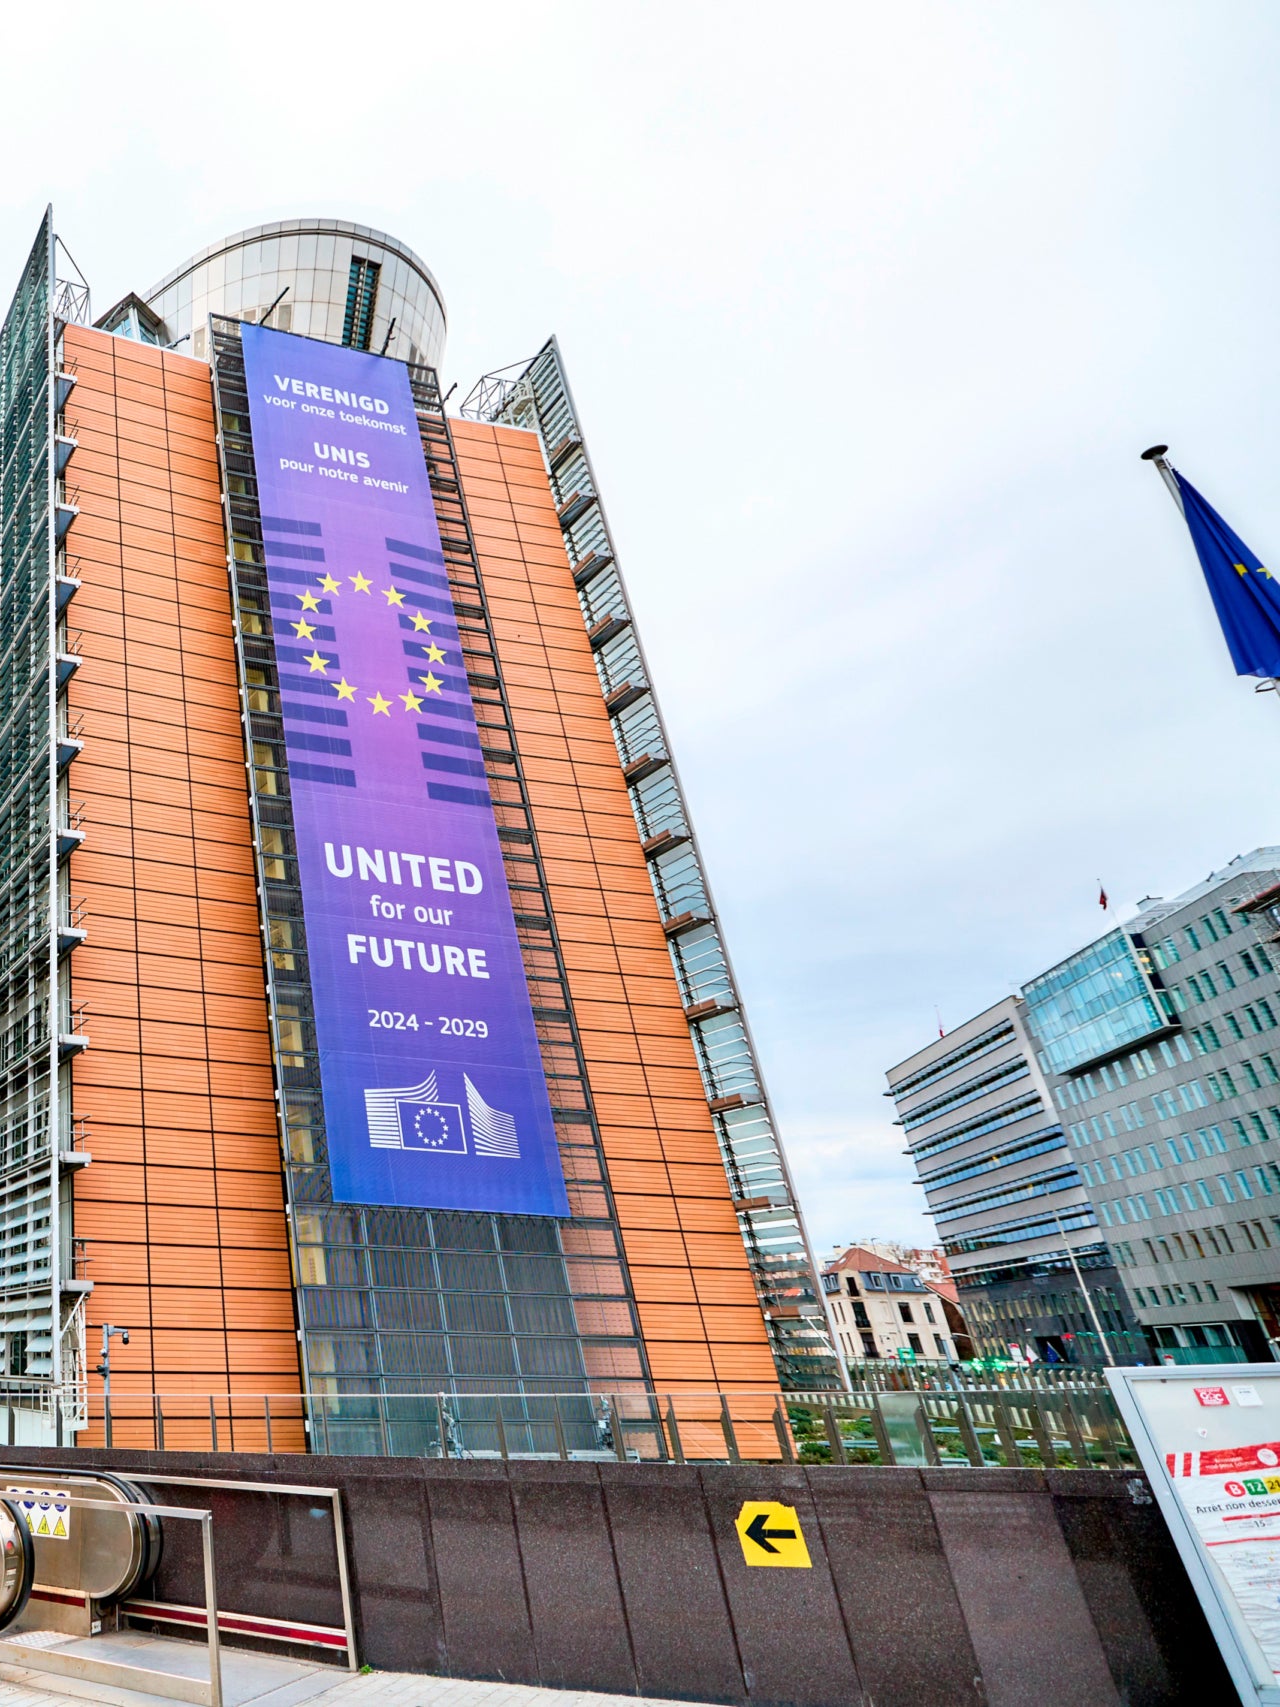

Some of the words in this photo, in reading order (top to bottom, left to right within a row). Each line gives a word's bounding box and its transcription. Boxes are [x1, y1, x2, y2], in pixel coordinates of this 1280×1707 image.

[273, 374, 390, 415] VERENIGD
[263, 394, 297, 410] voor
[301, 403, 335, 420] onze
[339, 410, 408, 436] toekomst
[313, 442, 371, 469] UNIS
[279, 457, 314, 474] pour
[318, 466, 359, 483] notre
[363, 476, 409, 494] avenir
[324, 842, 483, 895] UNITED
[369, 894, 406, 920] for
[413, 906, 454, 926] our
[346, 933, 491, 979] FUTURE
[367, 1009, 420, 1032] 2024
[438, 1016, 489, 1039] 2029
[1229, 1484, 1241, 1495] B
[1246, 1481, 1265, 1493] 12
[1225, 1501, 1246, 1511] non
